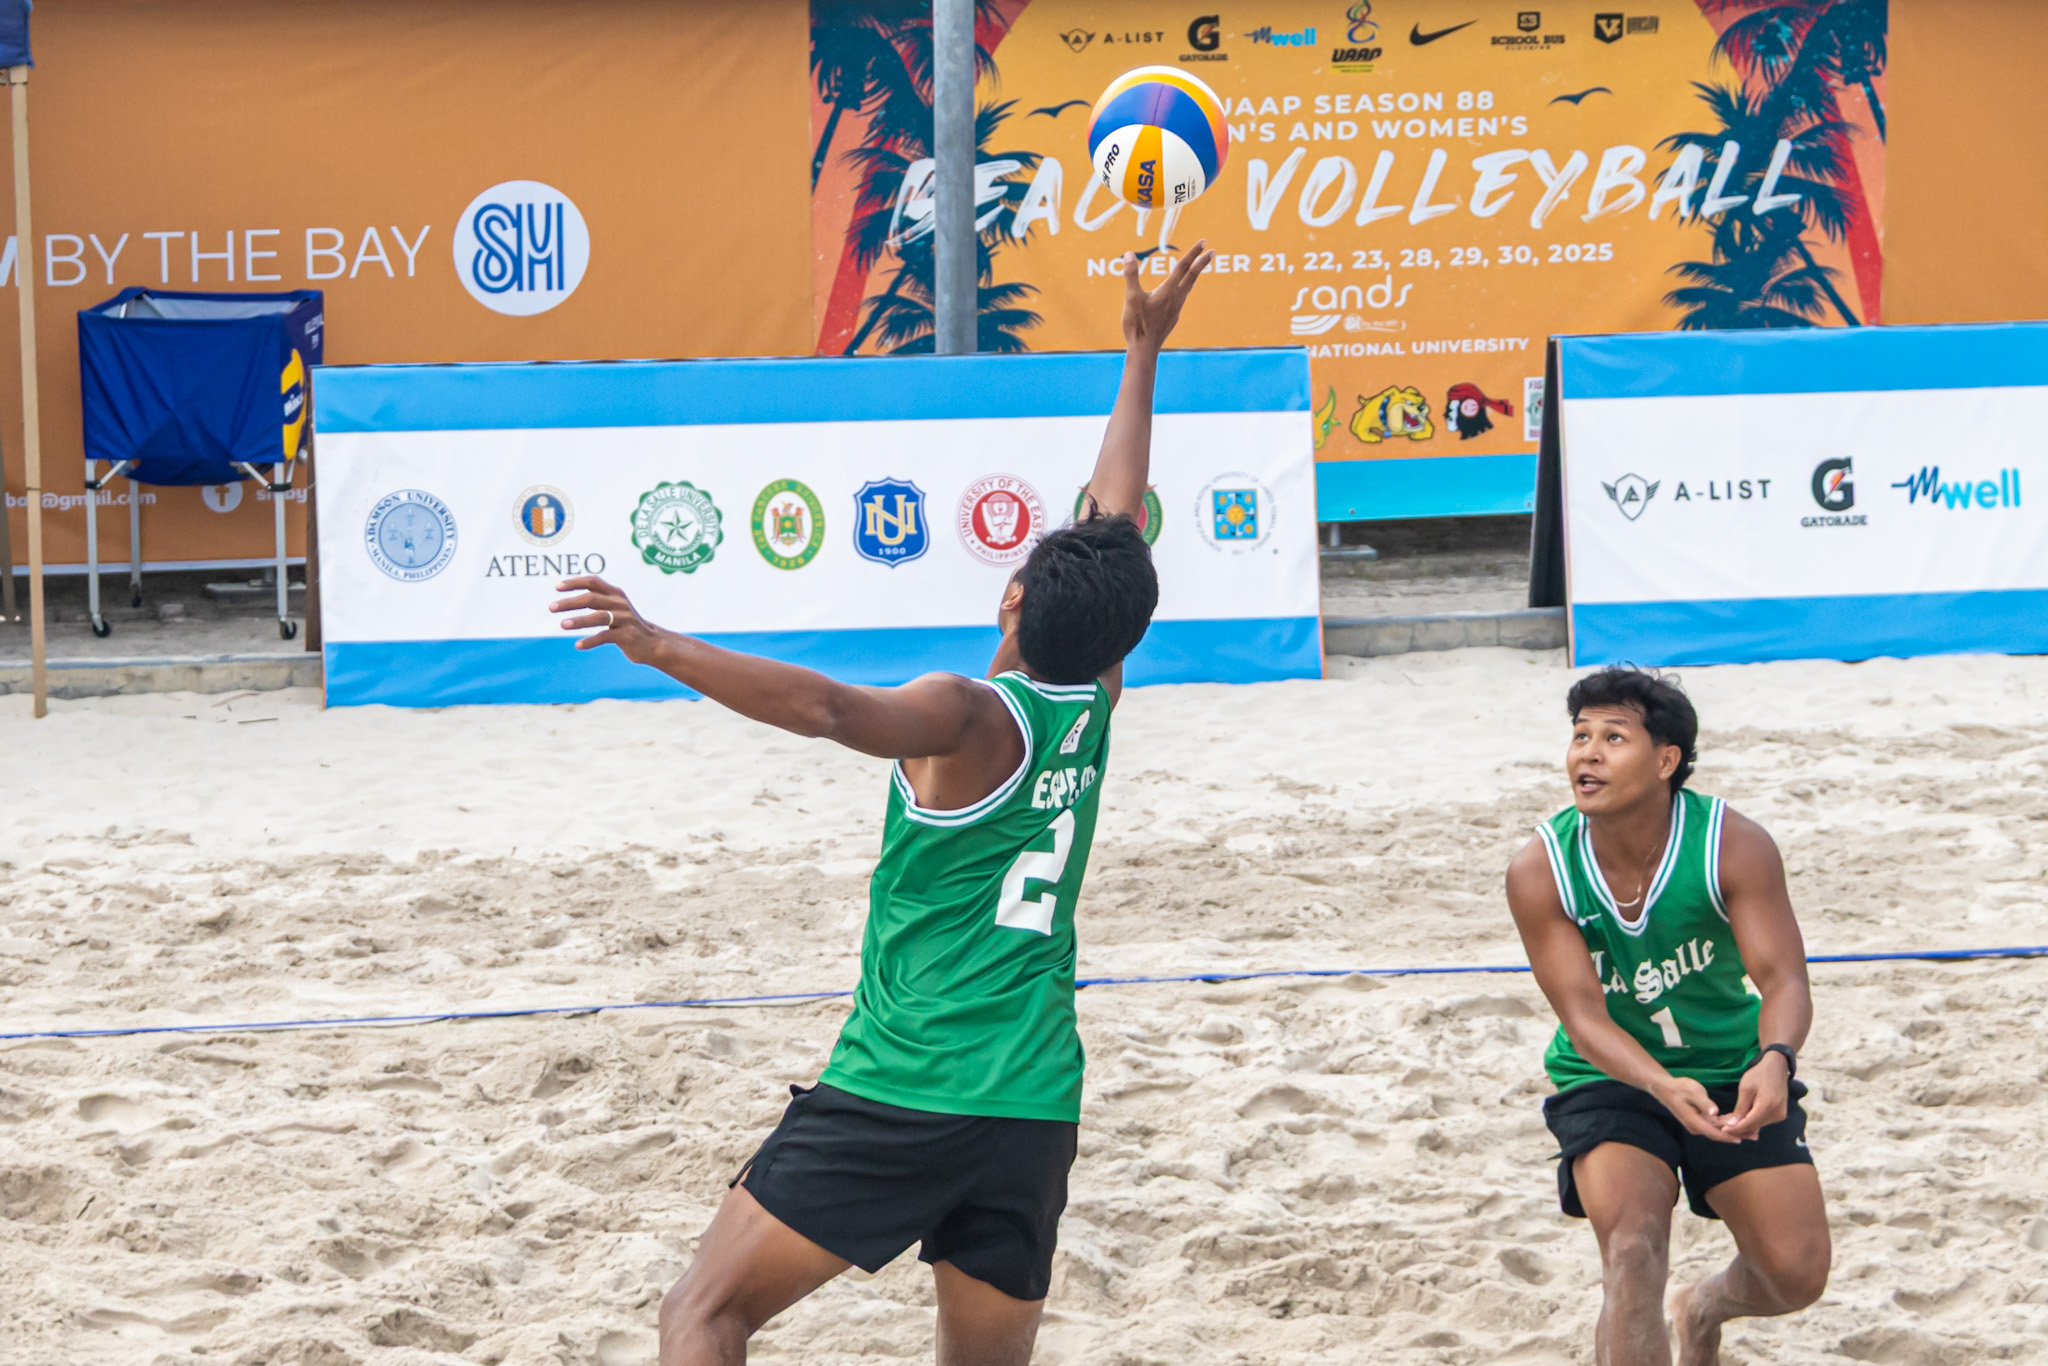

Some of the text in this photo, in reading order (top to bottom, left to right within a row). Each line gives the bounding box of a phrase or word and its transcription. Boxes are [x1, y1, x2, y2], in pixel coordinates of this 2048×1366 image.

[1103, 31, 1164, 44] A-LIST
[1491, 35, 1539, 46] SCHOOL
[1314, 92, 1443, 115] SEASON
[1456, 90, 1495, 111] 88
[1288, 121, 1359, 141] AND
[1371, 116, 1529, 139] WOMEN'S
[1102, 143, 1121, 175] PRO
[1246, 138, 1803, 232] VOLLEYBALL
[45, 232, 129, 287] BY
[143, 229, 282, 285] THE
[305, 225, 431, 280] BAY
[472, 202, 565, 294] SM
[1259, 253, 1294, 274] 21,
[1303, 251, 1343, 272] 22,
[1352, 250, 1391, 271] 23,
[1400, 248, 1441, 270] 28,
[1449, 246, 1490, 268] 29,
[1498, 245, 1540, 266] 30,
[1548, 242, 1614, 263] 2025
[1290, 274, 1413, 311] sands
[1412, 337, 1529, 355] UNIVERSITY
[645, 486, 676, 509] SALLE
[1675, 479, 1772, 502] A-LIST
[367, 495, 400, 543] ADAMSON
[407, 491, 455, 540] UNIVERSITY
[638, 508, 651, 521] LA
[678, 487, 718, 537] UNIVERSITY
[960, 479, 994, 537] UNIVERSITY
[998, 478, 1013, 489] OF
[1016, 484, 1036, 506] THE
[637, 524, 650, 538] DE
[1801, 515, 1868, 528] GATORADE
[653, 551, 702, 567] MANILA
[878, 546, 906, 555] 1900
[976, 543, 1030, 560] PHILIPPINES
[486, 553, 606, 577] ATENEO
[994, 808, 1076, 937] 2
[1591, 937, 1715, 1005] La Salle
[1650, 1006, 1690, 1049] 1
